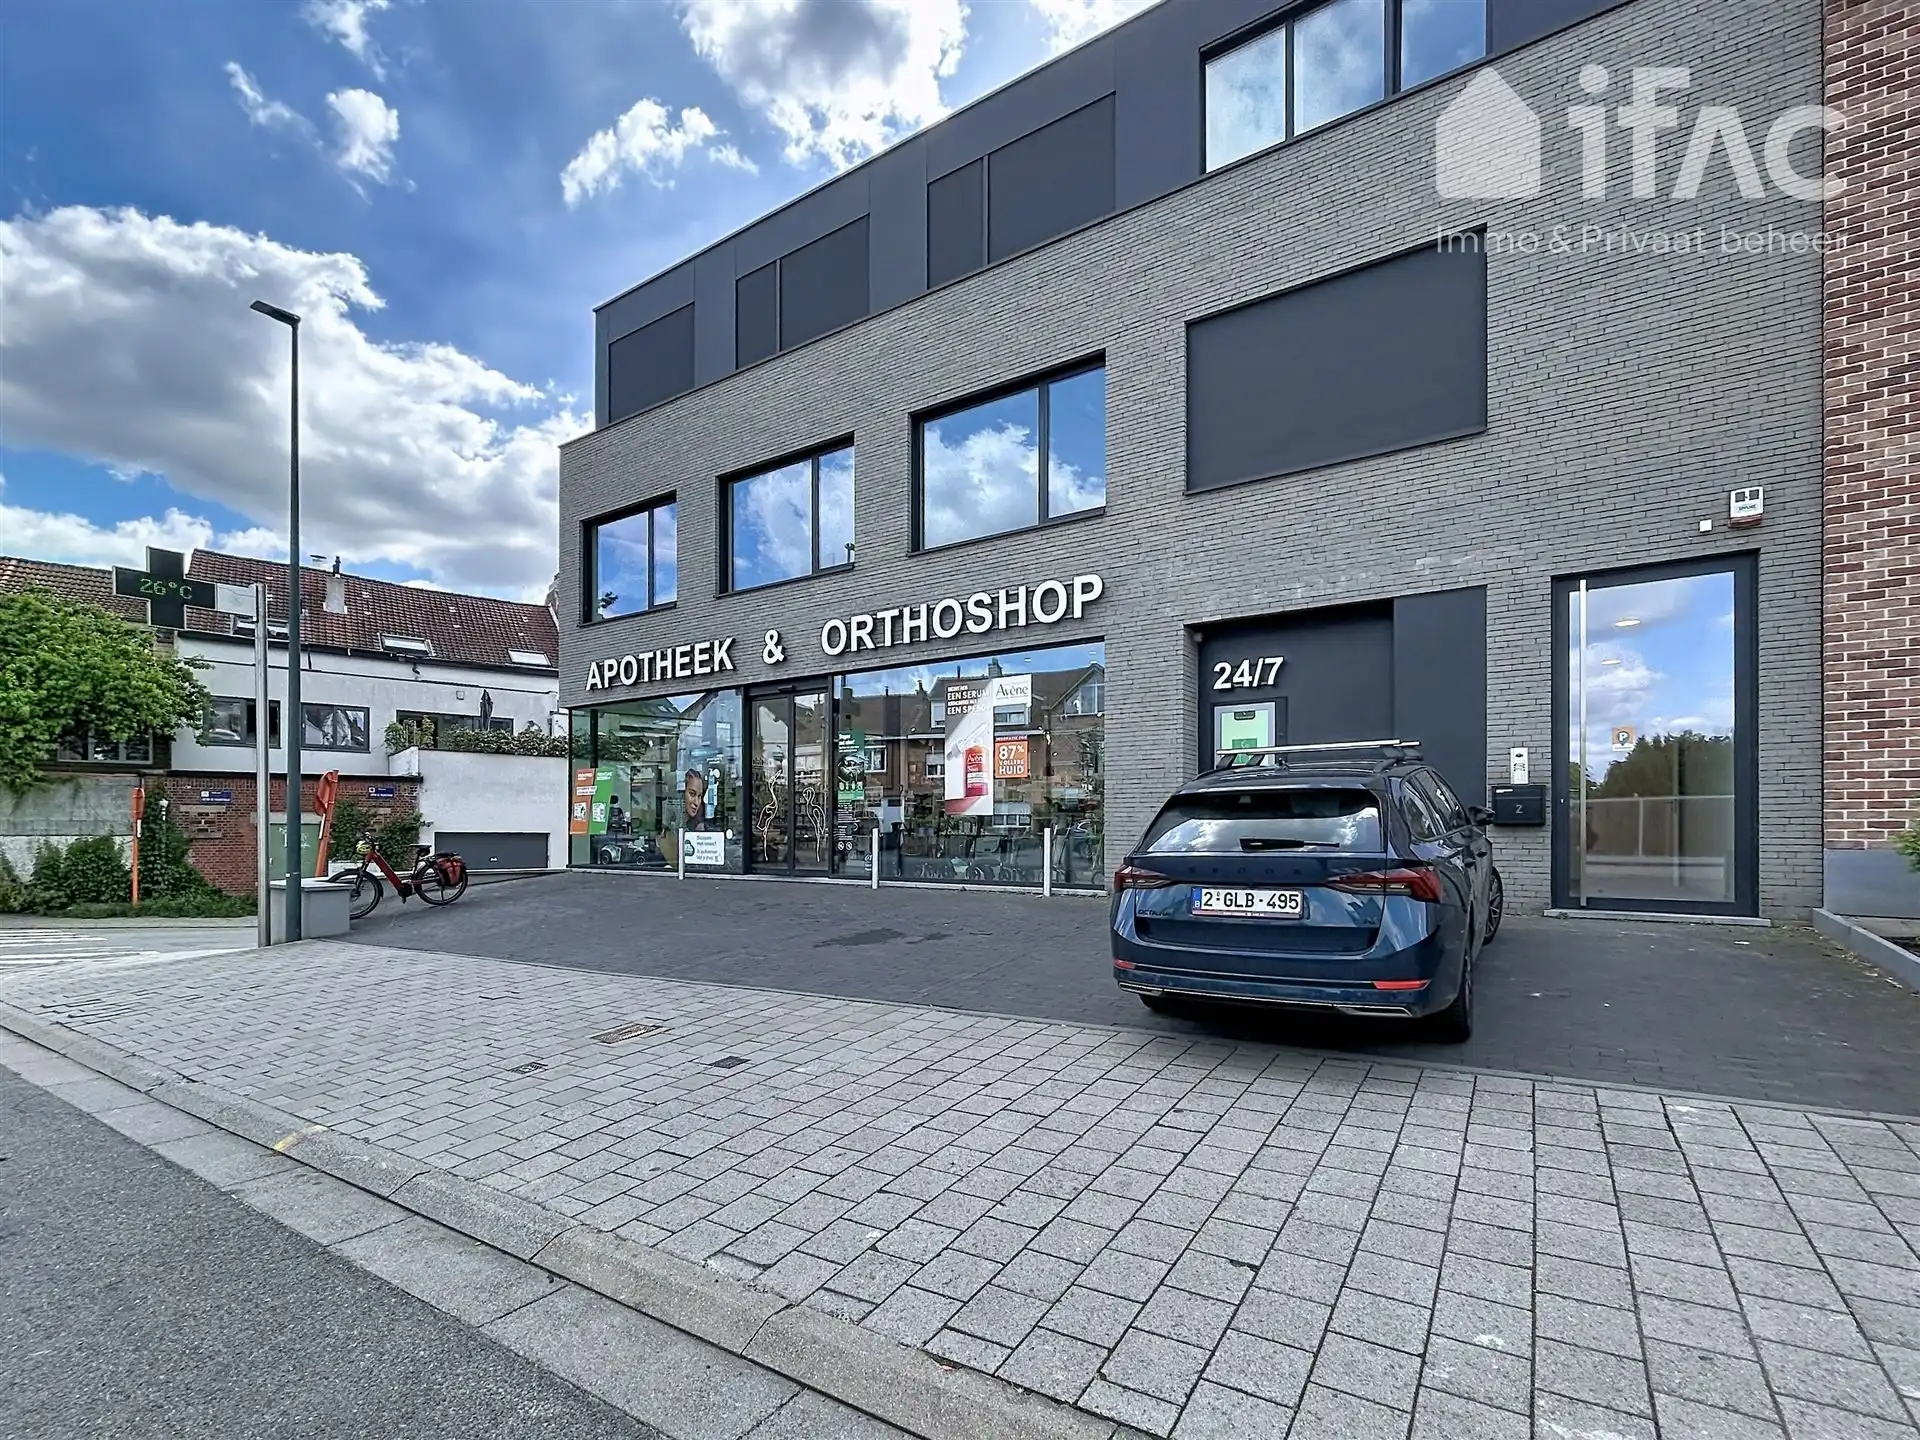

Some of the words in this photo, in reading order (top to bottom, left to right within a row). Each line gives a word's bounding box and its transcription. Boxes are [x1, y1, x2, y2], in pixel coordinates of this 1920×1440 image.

[140, 578, 192, 600] 26°C
[585, 637, 736, 691] APOTHEEK
[762, 629, 785, 665] &
[820, 573, 1104, 656] ORTHOSHOP
[1213, 656, 1284, 690] 24/7
[947, 692, 961, 701] EEN
[995, 683, 1029, 697] Avène
[947, 706, 961, 715] EEN
[998, 744, 1025, 760] 87%
[999, 765, 1025, 775] HUID
